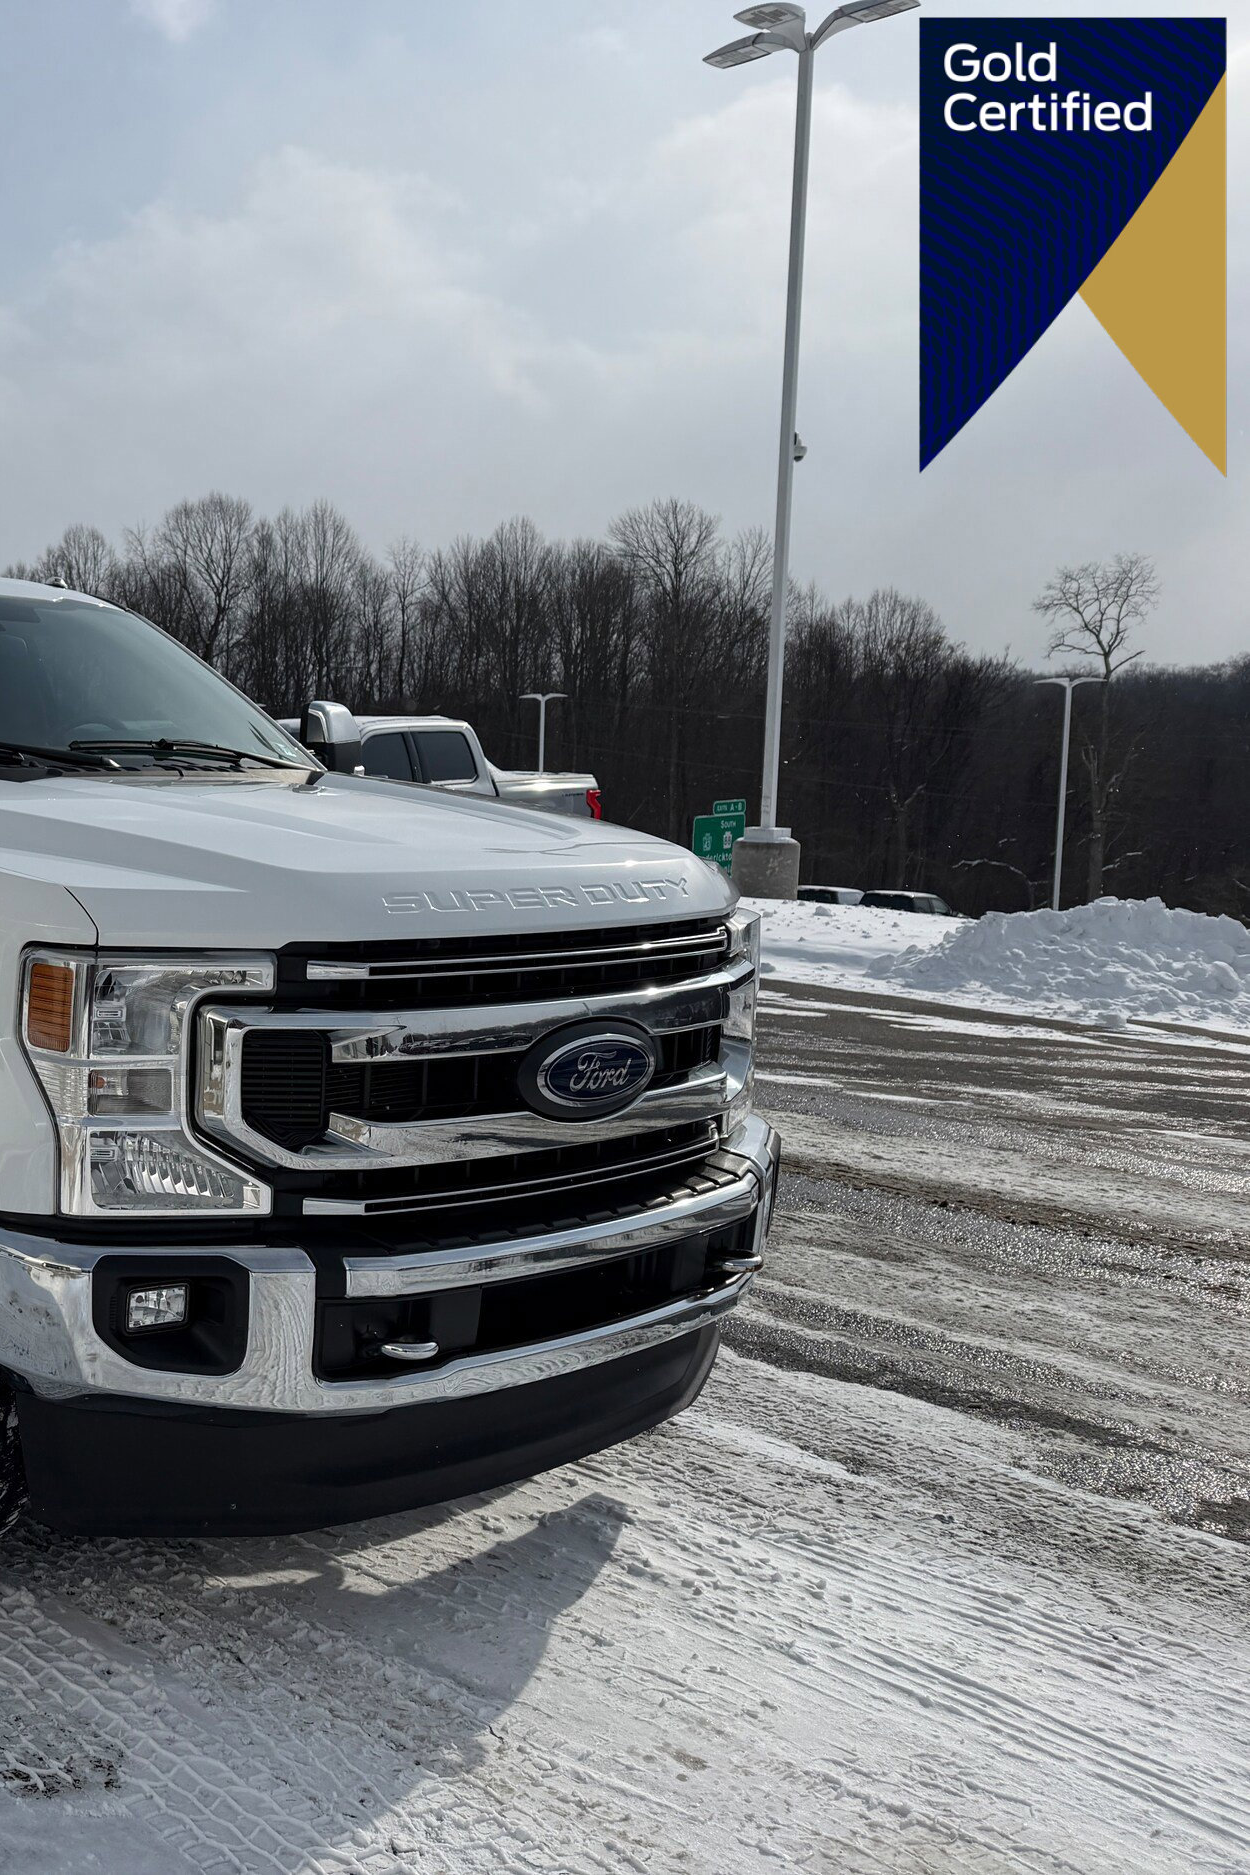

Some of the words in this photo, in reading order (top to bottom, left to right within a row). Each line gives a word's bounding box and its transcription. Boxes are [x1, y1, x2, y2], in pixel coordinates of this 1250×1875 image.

[381, 886, 580, 914] SUPER
[579, 877, 690, 907] DUTY
[569, 1050, 633, 1093] Ford
